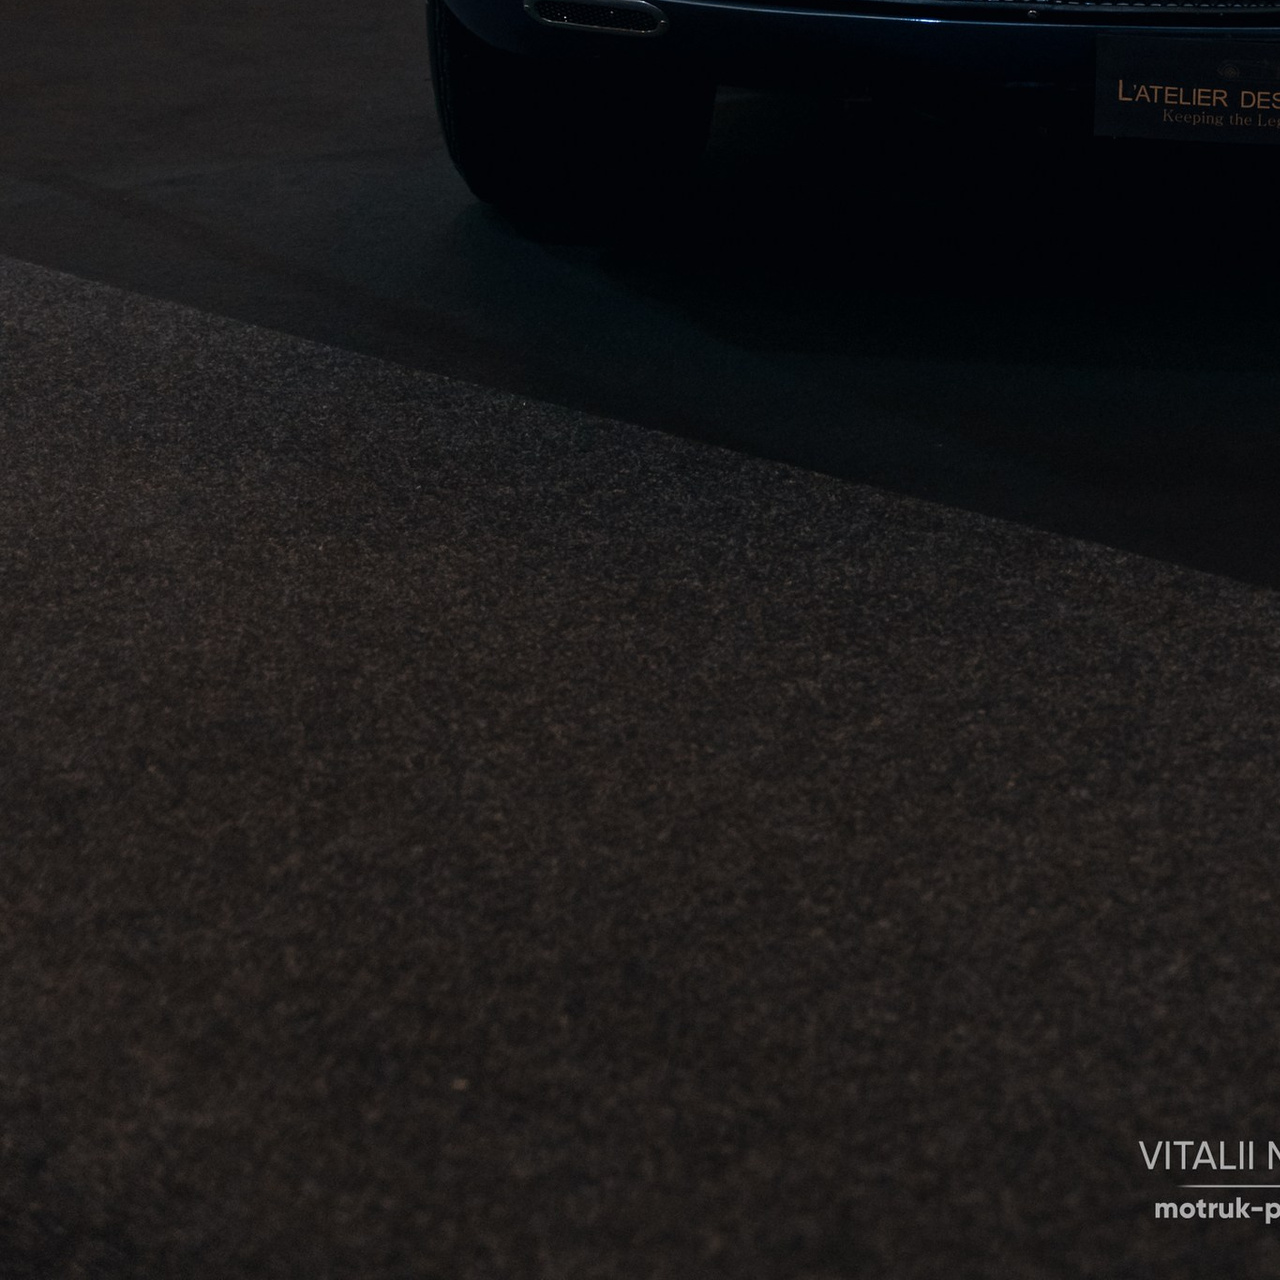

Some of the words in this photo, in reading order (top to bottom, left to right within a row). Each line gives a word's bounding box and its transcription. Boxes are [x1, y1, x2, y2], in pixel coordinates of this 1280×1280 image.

[1117, 79, 1228, 108] L'ATELIER
[1162, 109, 1224, 126] Keeping
[1229, 112, 1252, 126] the
